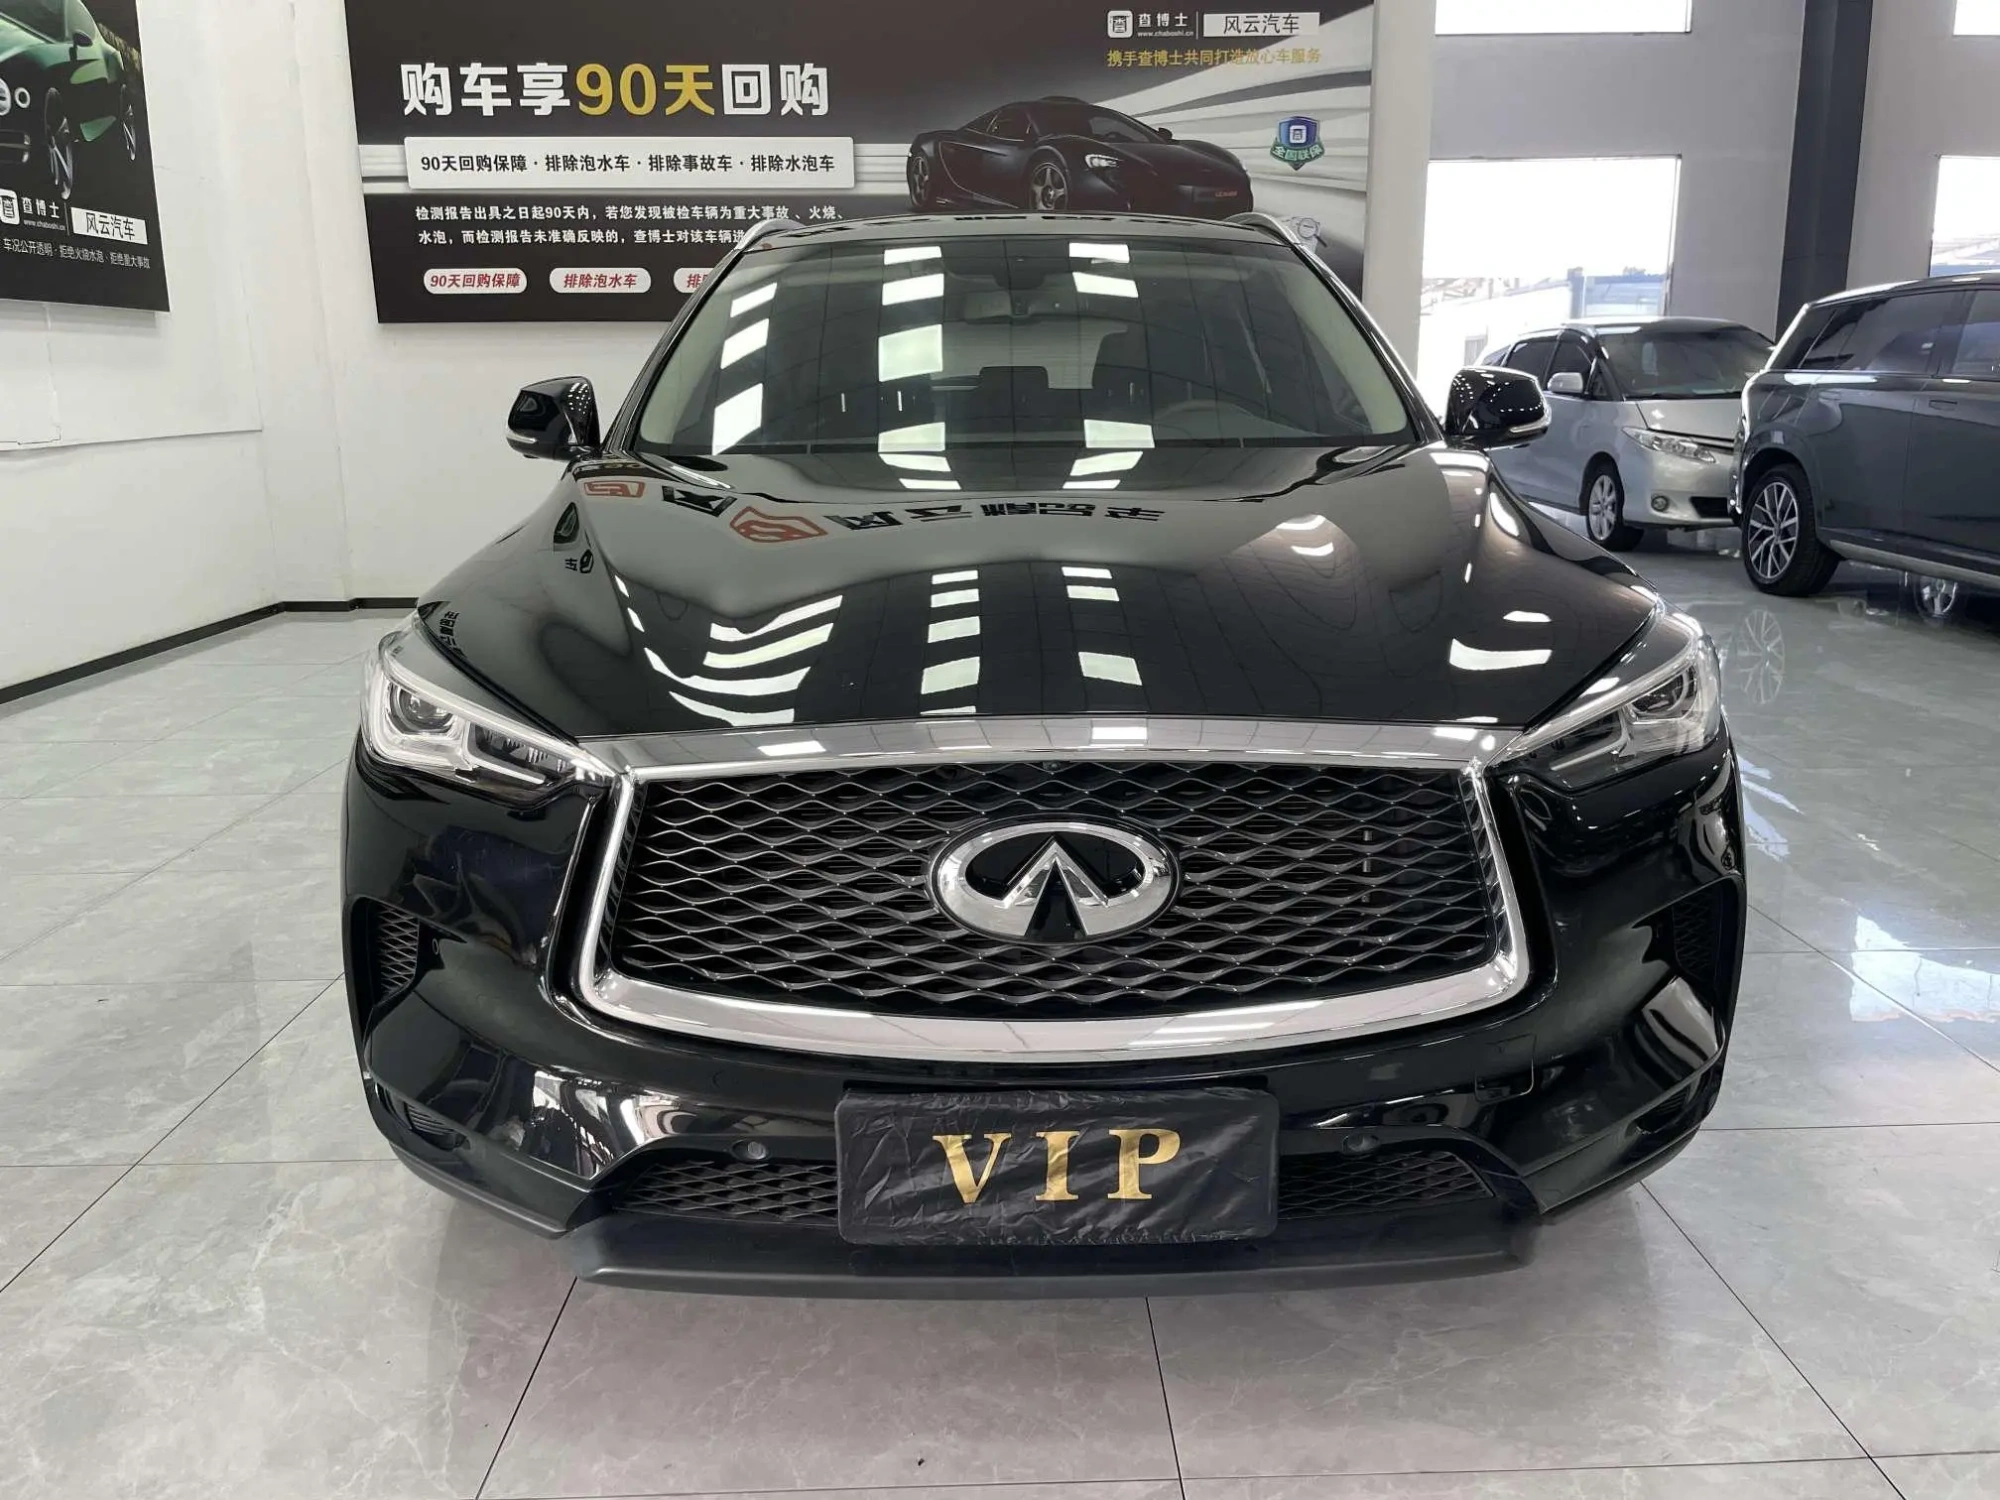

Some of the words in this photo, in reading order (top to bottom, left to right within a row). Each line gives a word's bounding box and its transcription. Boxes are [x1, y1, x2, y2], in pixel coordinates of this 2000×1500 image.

[1138, 13, 1188, 27] 查博士
[1224, 13, 1299, 34] 风云汽车
[1107, 48, 1322, 68] 携手查博士共同打造放心车服务
[401, 62, 829, 116] 购车享90天回购
[21, 196, 60, 219] 查博士
[86, 212, 135, 240] 风云汽车
[430, 273, 521, 288] 90天回购保障
[564, 273, 637, 288] 排除泡水车
[932, 1127, 1181, 1204] VIP
